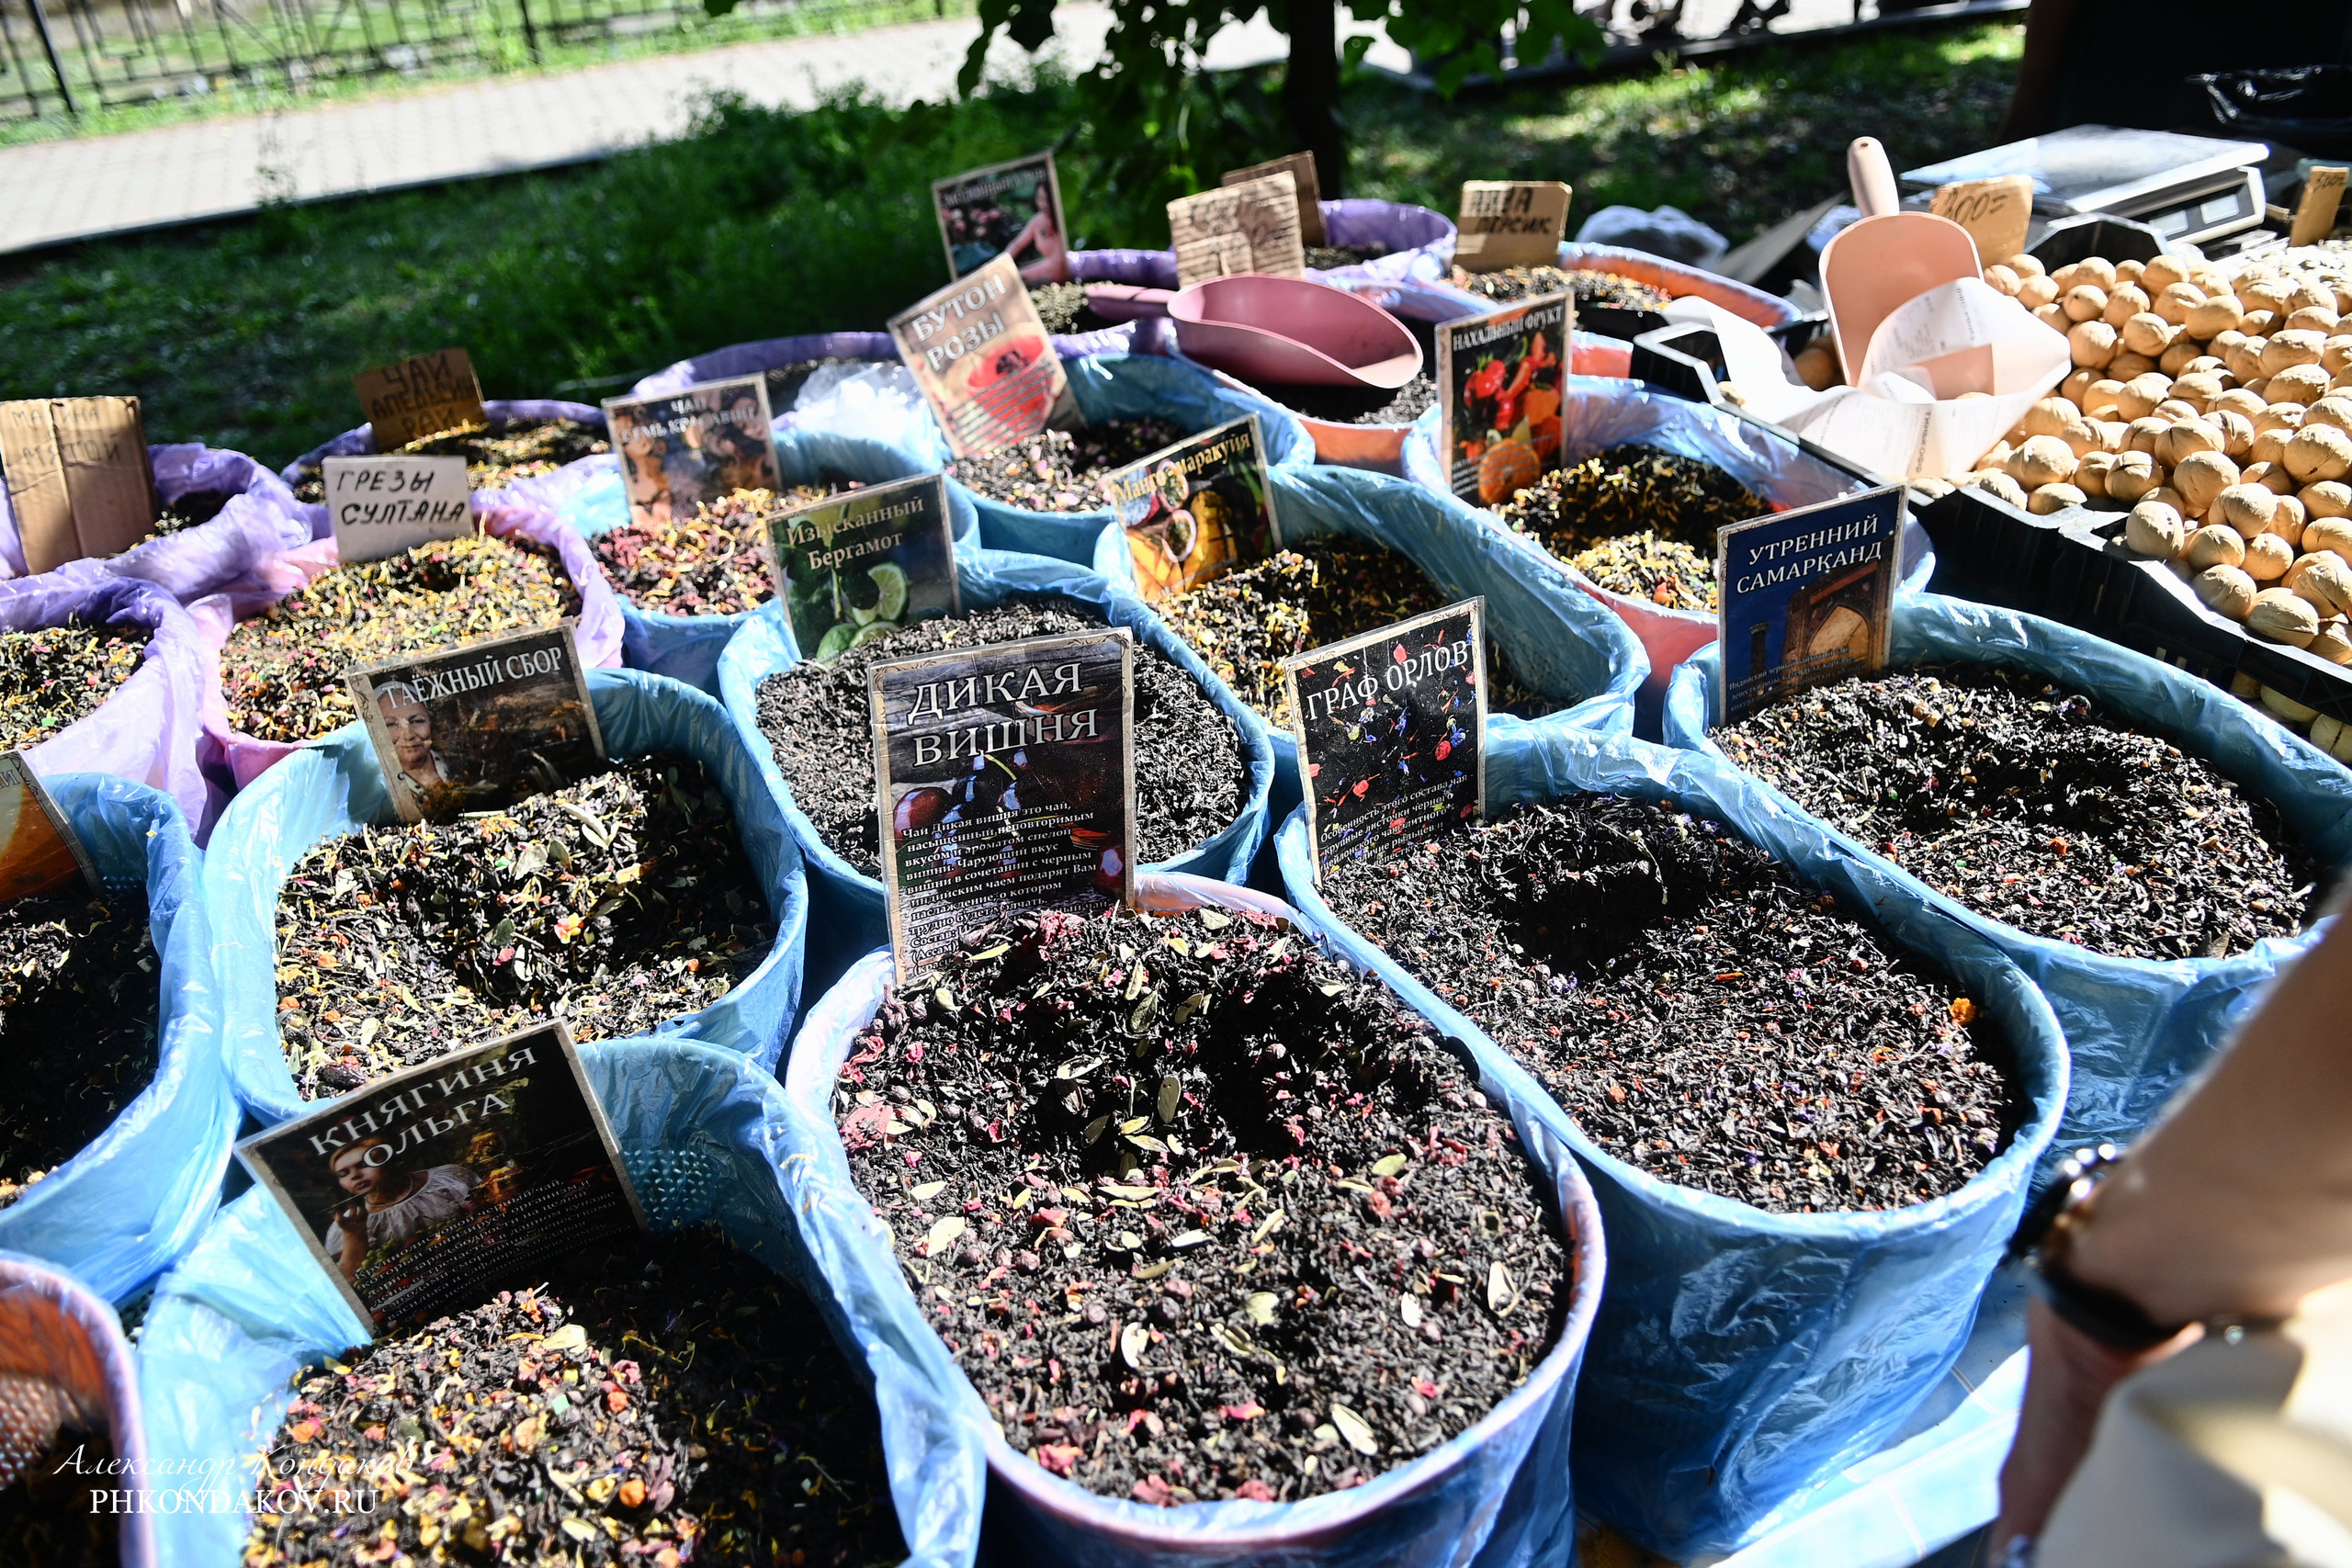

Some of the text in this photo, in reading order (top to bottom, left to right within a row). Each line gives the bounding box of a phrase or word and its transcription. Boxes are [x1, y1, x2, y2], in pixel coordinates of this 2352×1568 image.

[911, 273, 1007, 343] БУТОН
[1453, 305, 1563, 352] НАХАЛЬНЫЙ ФРУКТ
[926, 311, 1006, 371] РОЗЫ
[12, 408, 101, 428] МАИНА
[622, 407, 756, 443] СЕМЬ КРАСАВИЦ
[671, 396, 707, 414] ЧАЙ
[336, 470, 435, 492] ГРЕЗЫ
[341, 500, 465, 525] СУЛТАНА
[786, 495, 924, 546] Изысканный
[808, 532, 903, 570] Бергамот
[1748, 513, 1879, 566] УТРЕННИЙ
[1736, 542, 1882, 594] САМАРКАНД
[381, 647, 562, 709] ТАЁЖНЫЙ СБОР
[907, 663, 1081, 726] ДИКАЯ
[1305, 640, 1468, 721] ГРАФ ОРЛОВ
[1729, 670, 1767, 691] Индийский
[913, 708, 1099, 767] ВИШНЯ
[902, 802, 1071, 840] Чай Дикая вишня это чай,
[1321, 774, 1467, 842] Особенность этого состава чая
[1324, 794, 1453, 856] крупные листочки черного
[905, 828, 1072, 867] вкусом и ароматом спелой
[906, 843, 1058, 881] вишни. Чарующий вкус
[1321, 808, 1446, 870] цейлонского чая элитного
[1357, 841, 1389, 863] аличие
[1392, 824, 1435, 849] рыльцев
[907, 877, 951, 895] вишни
[955, 874, 962, 883] в
[965, 861, 1029, 881] сочетании
[1041, 852, 1091, 867] черным
[910, 863, 1097, 908] индийским чаем подарят Вам
[909, 918, 954, 938] трудно
[956, 908, 989, 925] будет
[911, 882, 1062, 922] наслаждение, о котором
[910, 930, 956, 948] Состав:
[308, 1046, 537, 1156] КНЯГИНЯ
[363, 1093, 511, 1168] ОЛЬГА
[477, 1190, 532, 1216] черный
[534, 1179, 565, 1192] чай,
[360, 1251, 423, 1288] который
[424, 1213, 506, 1252] тонизирует
[509, 1184, 579, 1213] организм
[583, 1179, 591, 1188] и
[366, 1190, 587, 1298] дарит заряд бодрости на целый
[390, 1271, 448, 1307] ягодами
[534, 1202, 616, 1232] лепестками
[412, 1238, 495, 1282] встречается
[507, 1210, 562, 1235] данном
[564, 1191, 615, 1216] купаже
[387, 1281, 448, 1321] василька
[450, 1275, 461, 1283] и
[525, 1221, 587, 1247] создавая
[444, 1239, 563, 1298] необыкновенную
